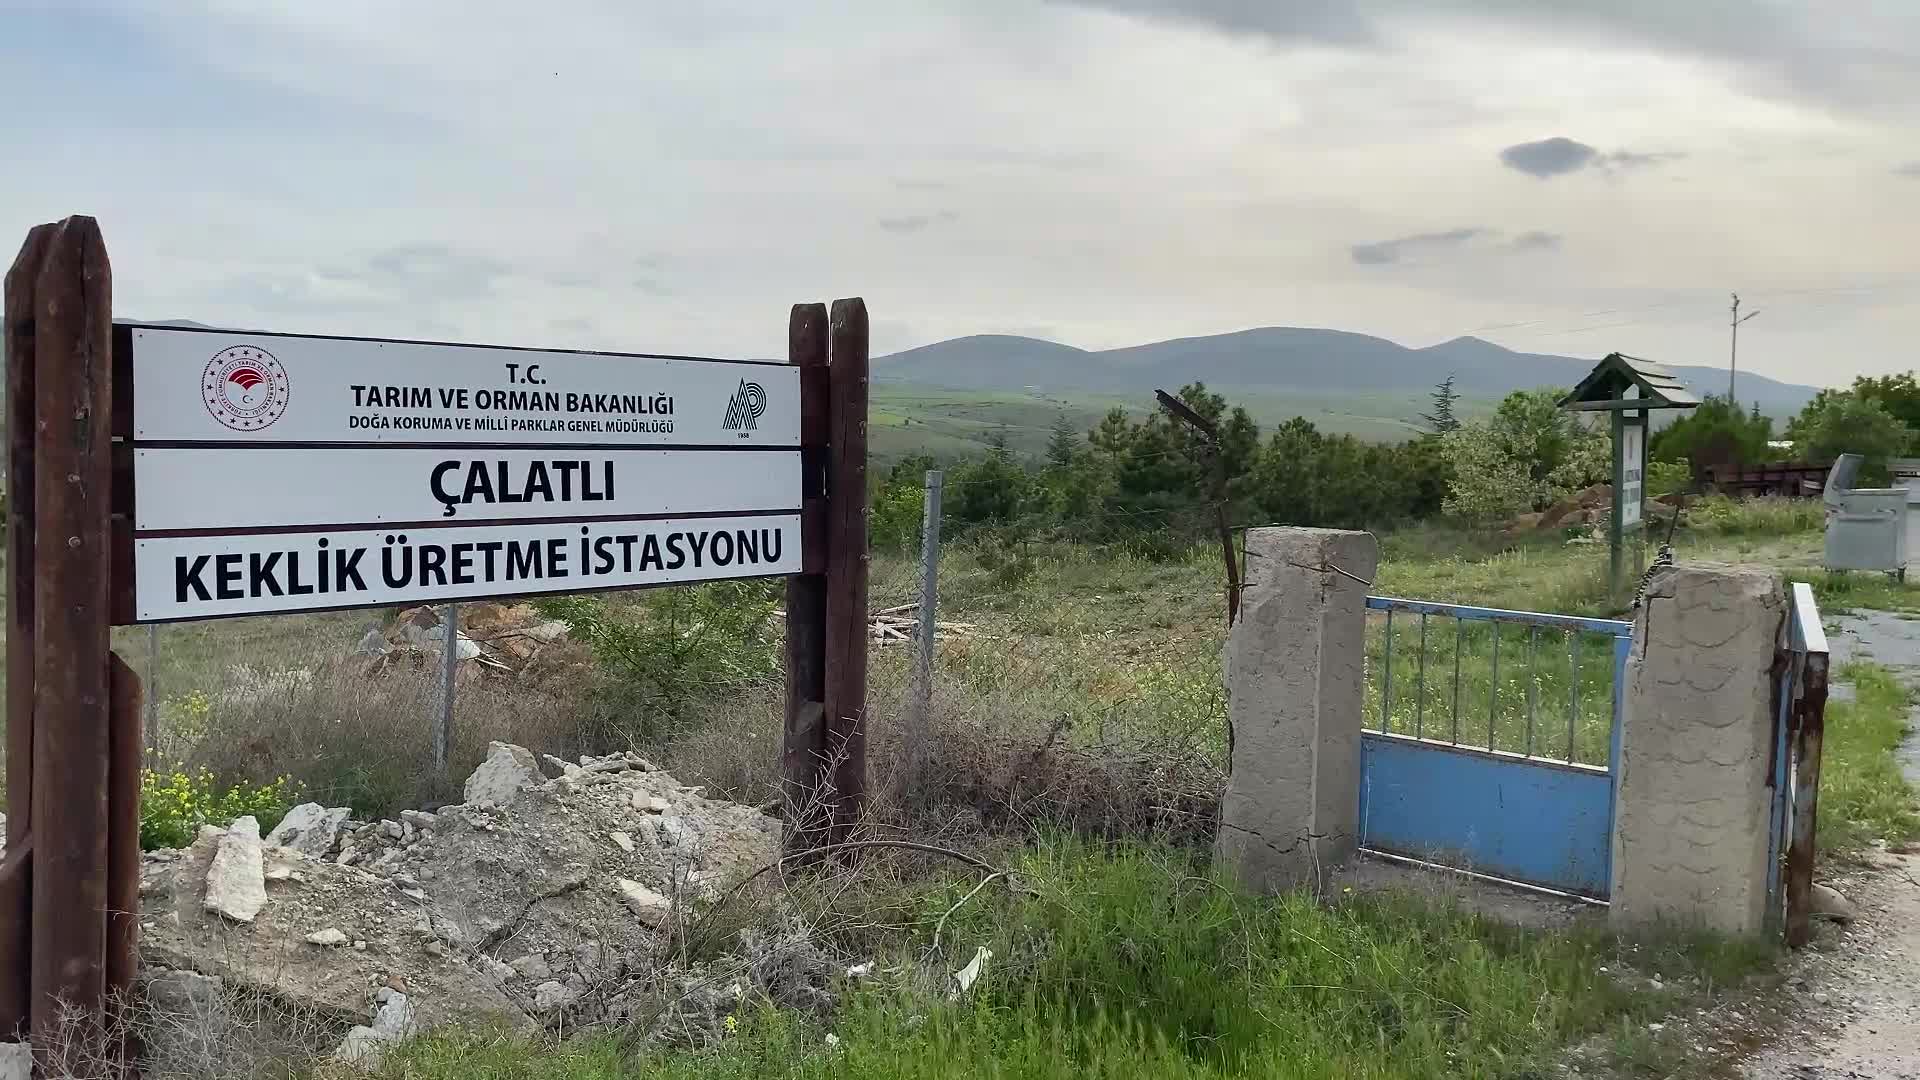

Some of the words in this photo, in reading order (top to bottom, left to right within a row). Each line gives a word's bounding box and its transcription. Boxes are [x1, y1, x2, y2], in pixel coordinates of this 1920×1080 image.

[505, 363, 547, 385] T.C.
[350, 384, 433, 409] TARIM
[438, 388, 469, 409] VE
[474, 389, 560, 412] ORMAN
[566, 391, 674, 415] BAKANLIĞI
[349, 412, 390, 429] DOĞA
[393, 416, 453, 430] KORUMA
[455, 417, 472, 430] VE
[511, 419, 566, 432] PARKLAR
[567, 420, 604, 433] GENEL
[605, 419, 674, 434] MÜDÜRLÜĞÜ
[430, 460, 615, 518] ÇALATLI
[175, 537, 369, 603] KEKLİK
[381, 534, 569, 589] ÜRETME
[580, 525, 782, 576] İSTASYONU
